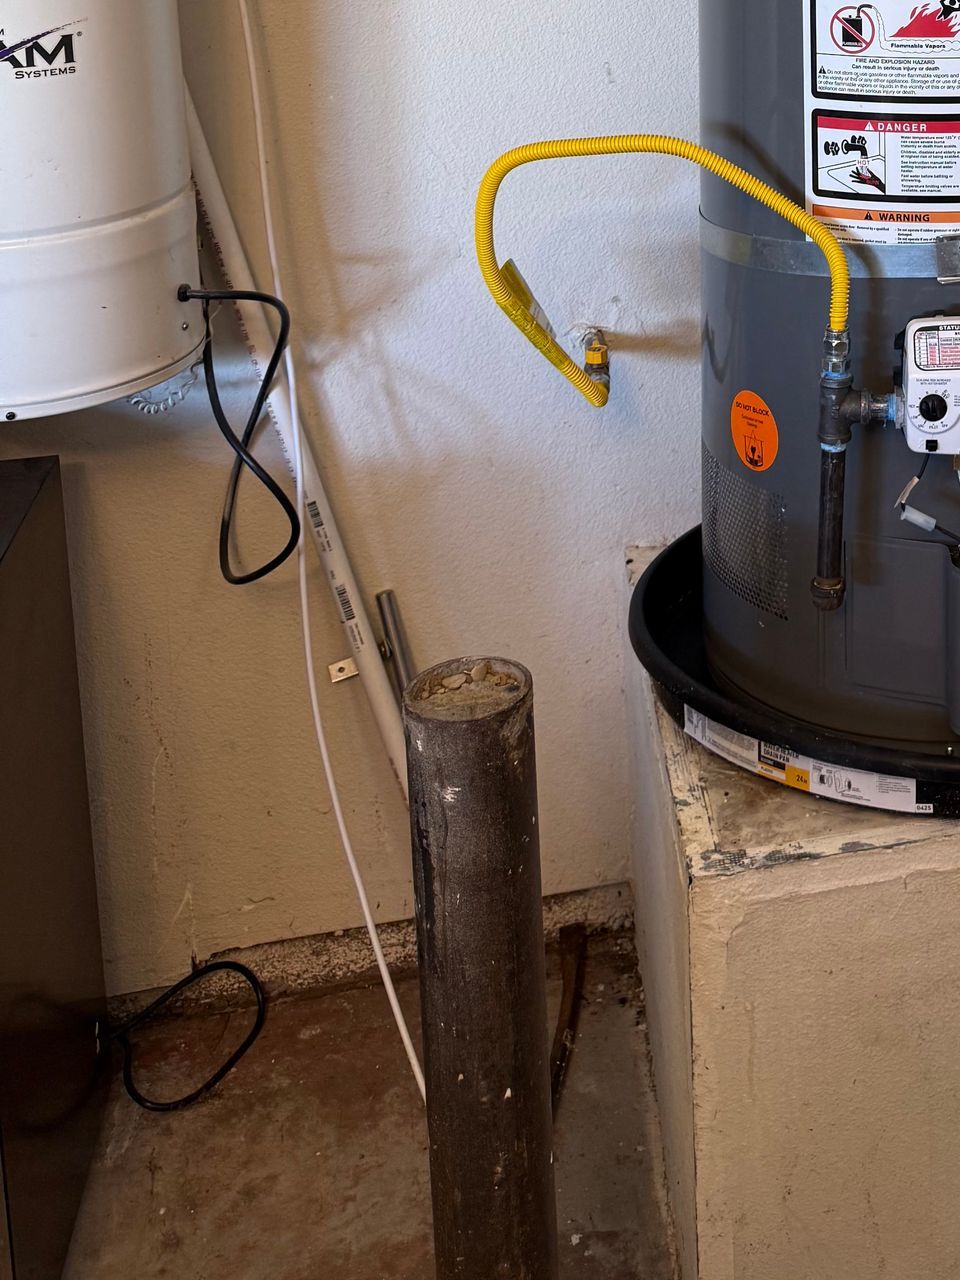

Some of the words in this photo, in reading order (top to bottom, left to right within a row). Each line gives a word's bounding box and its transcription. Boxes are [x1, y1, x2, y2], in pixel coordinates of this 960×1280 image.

[15, 66, 76, 79] SYSTEMS
[877, 123, 927, 132] DANGER
[879, 213, 930, 222] WARNING
[796, 774, 803, 782] 24
